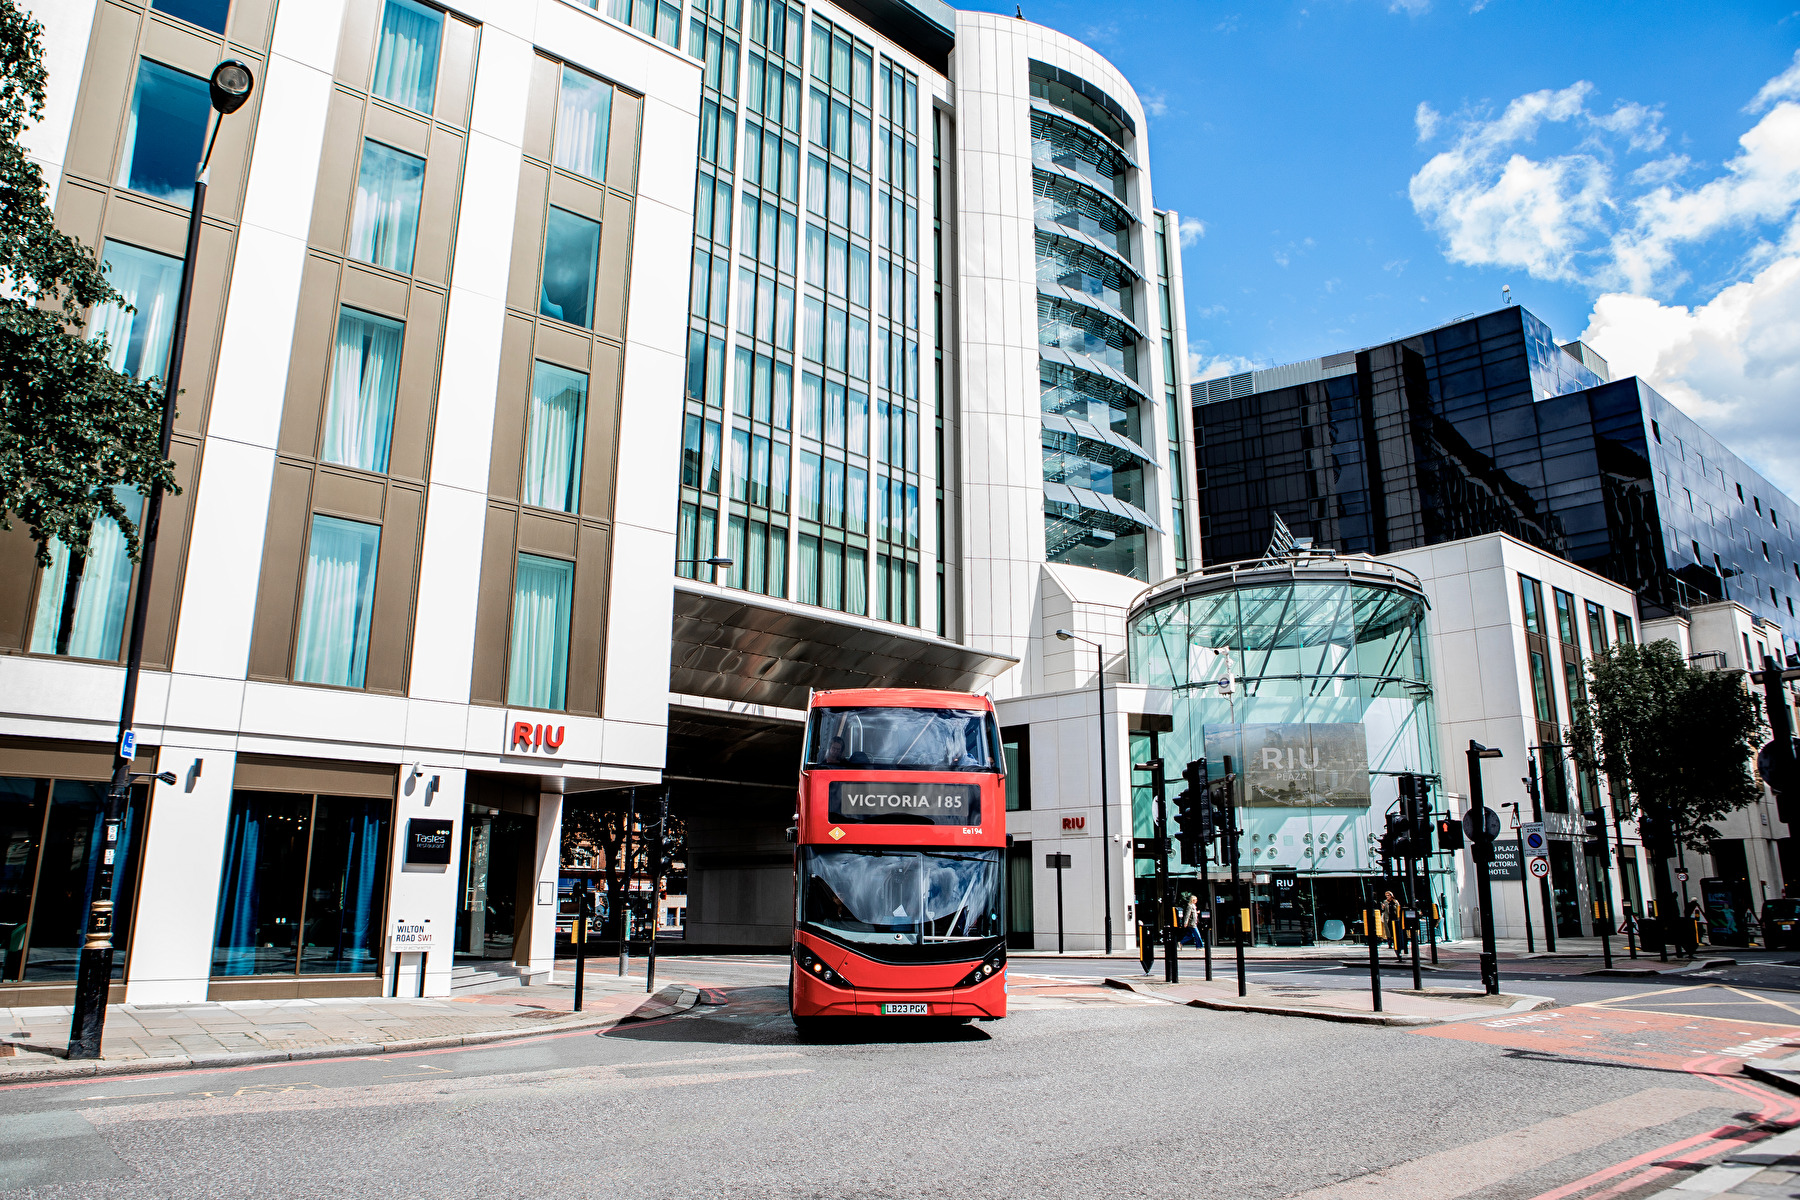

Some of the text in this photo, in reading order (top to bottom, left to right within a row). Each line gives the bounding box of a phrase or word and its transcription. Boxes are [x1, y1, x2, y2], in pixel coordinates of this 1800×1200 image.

[513, 721, 565, 748] RIU
[1262, 747, 1319, 769] RIU
[1276, 773, 1308, 781] PLAZA
[847, 794, 962, 808] VICTORIA 185
[1062, 816, 1085, 829] RIU
[962, 827, 983, 835] Ee194
[415, 833, 445, 843] Tastes
[1533, 863, 1547, 872] 20
[1276, 879, 1294, 887] RIU
[397, 925, 425, 933] WILTON
[396, 934, 432, 942] ROAD SW1
[886, 1004, 926, 1012] LB23 PGK
